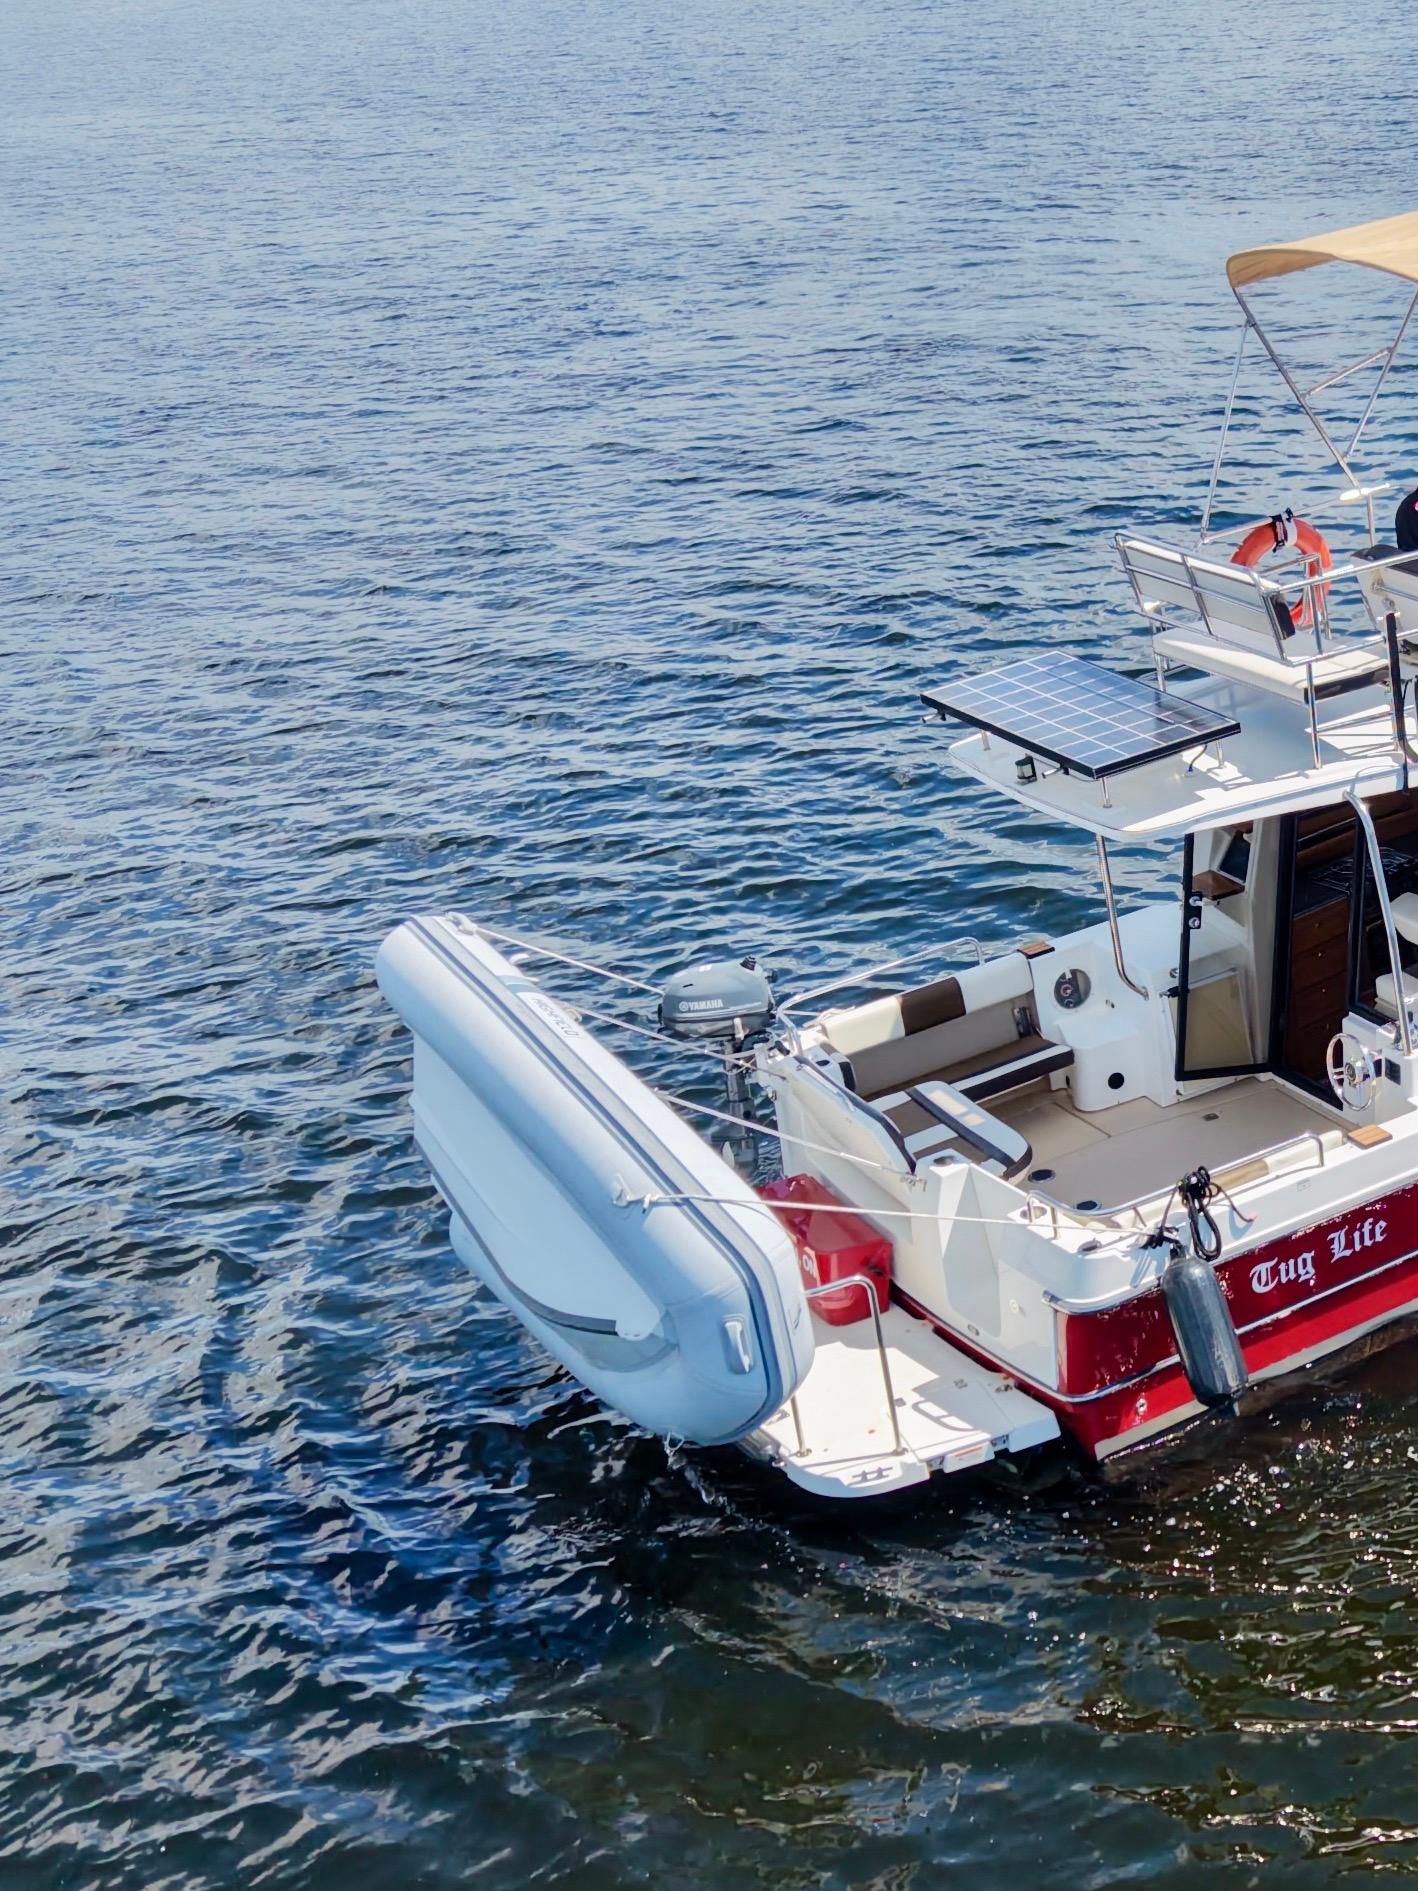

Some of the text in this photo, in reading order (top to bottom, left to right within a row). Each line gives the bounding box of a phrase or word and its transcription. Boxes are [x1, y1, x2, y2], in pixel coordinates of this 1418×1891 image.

[690, 999, 724, 1010] YAMAHA
[1249, 1217, 1388, 1294] Tug Life
